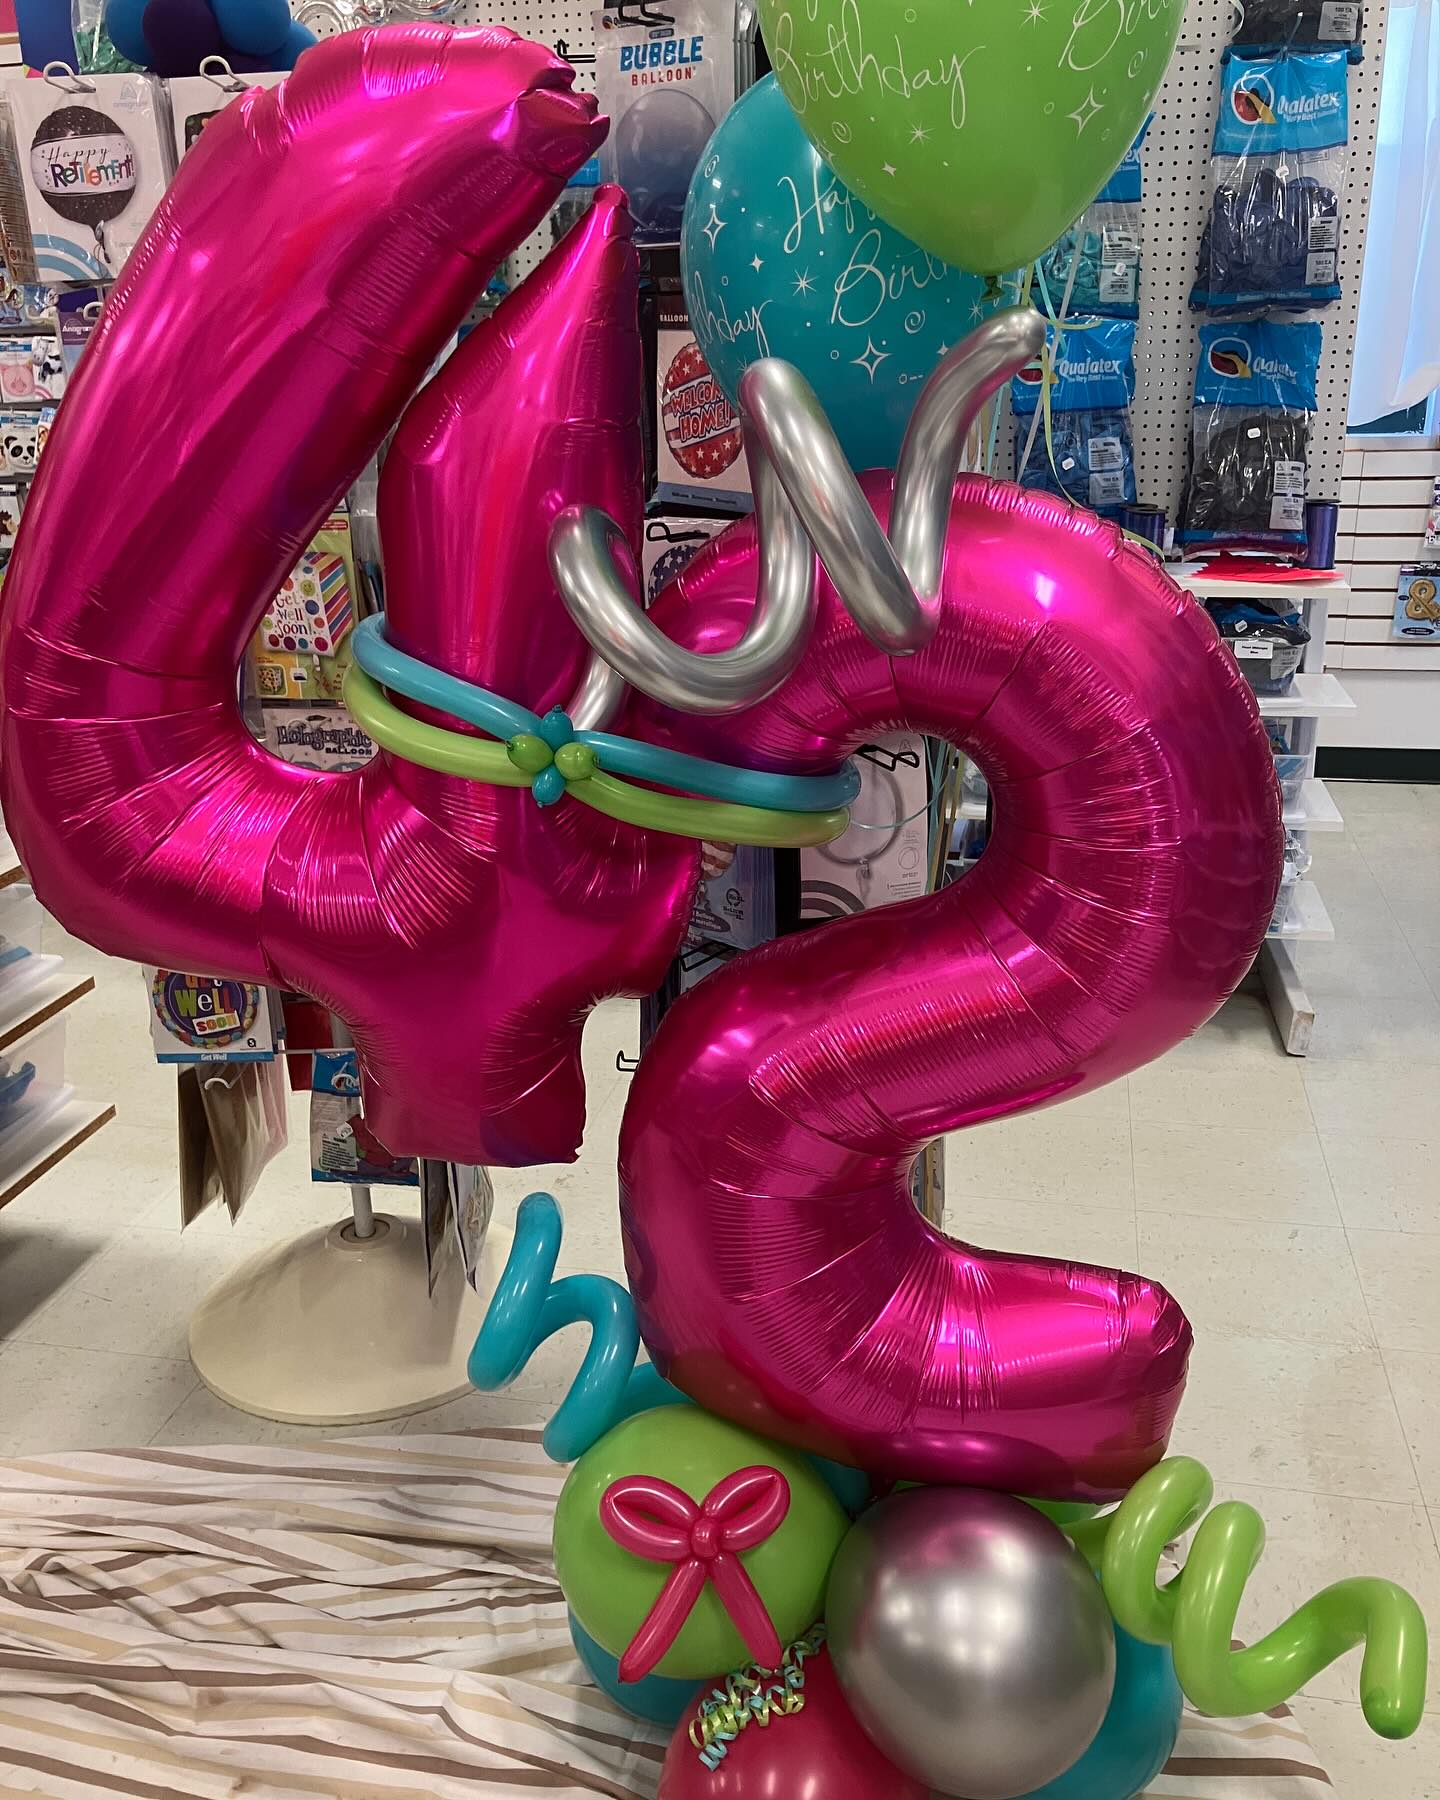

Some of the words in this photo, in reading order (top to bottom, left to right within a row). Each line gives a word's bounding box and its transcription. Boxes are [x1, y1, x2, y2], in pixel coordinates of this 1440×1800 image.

[620, 36, 704, 72] BUBBLE
[631, 67, 692, 86] BALLOON
[48, 146, 110, 167] Happy
[1059, 357, 1122, 382] Qualatex
[679, 401, 731, 442] HOME!
[275, 591, 300, 608] Get
[277, 726, 372, 751] Holographic
[325, 747, 372, 757] BALLOON
